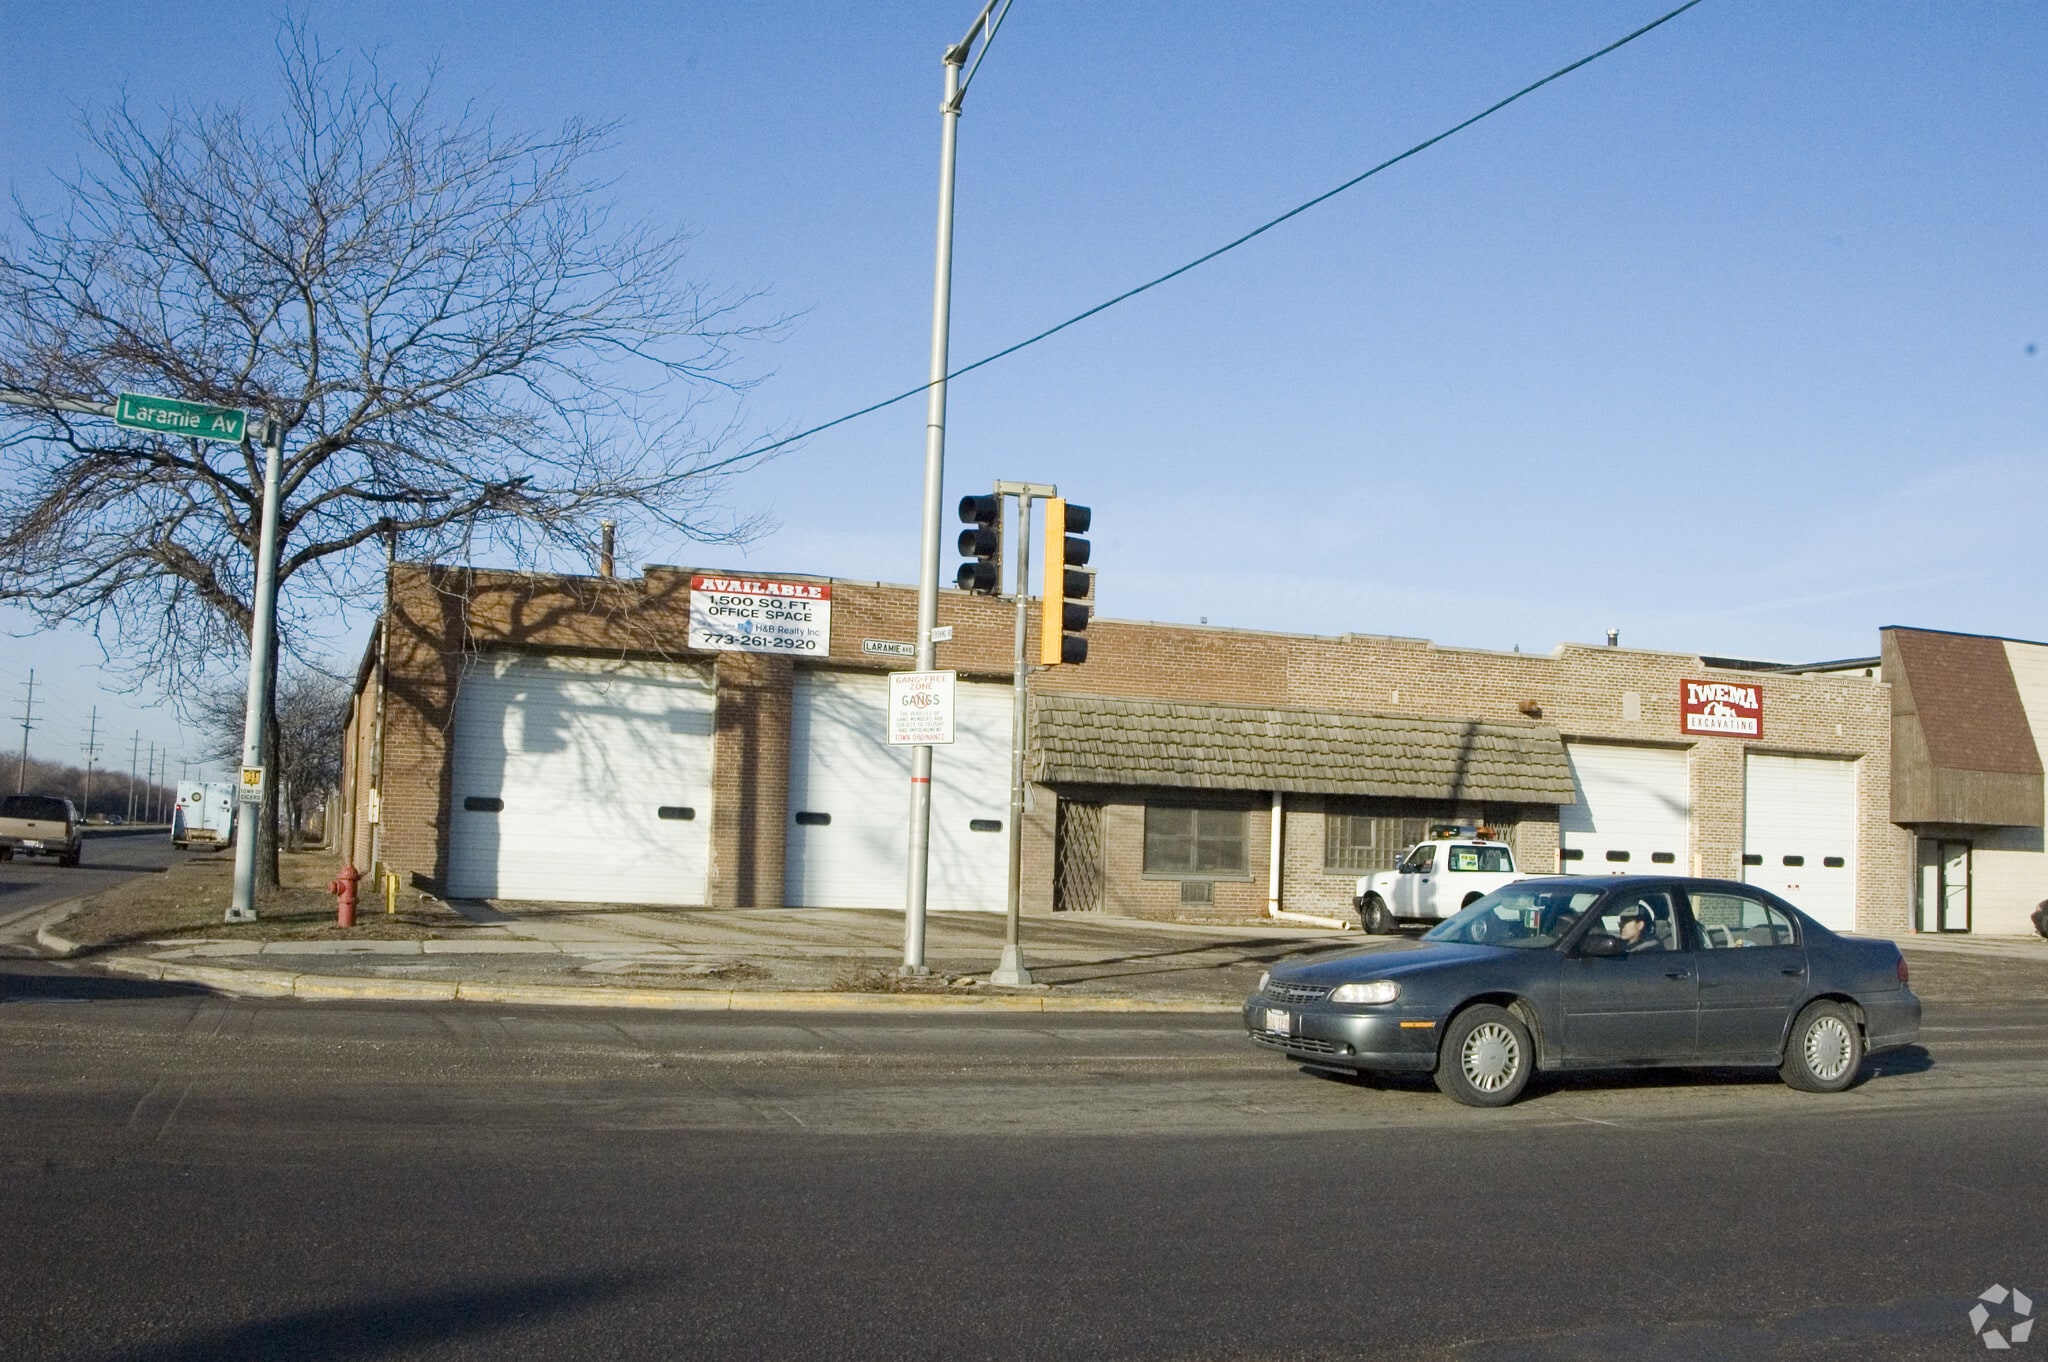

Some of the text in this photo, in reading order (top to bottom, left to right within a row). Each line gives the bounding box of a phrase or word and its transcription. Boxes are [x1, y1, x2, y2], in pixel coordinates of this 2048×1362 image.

[123, 400, 237, 433] Laramie Av
[700, 578, 822, 599] AVAILABLE
[709, 595, 754, 607] 1,500
[708, 606, 813, 622] OFFICE SPACE
[755, 624, 775, 633] H&B
[777, 625, 805, 637] Realty
[702, 633, 816, 650] 773-261-2920
[866, 642, 901, 653] LARAMIE
[902, 694, 940, 706] GANGS
[1687, 683, 1759, 709] IWEMA
[1691, 717, 1754, 731] EXCAVATING
